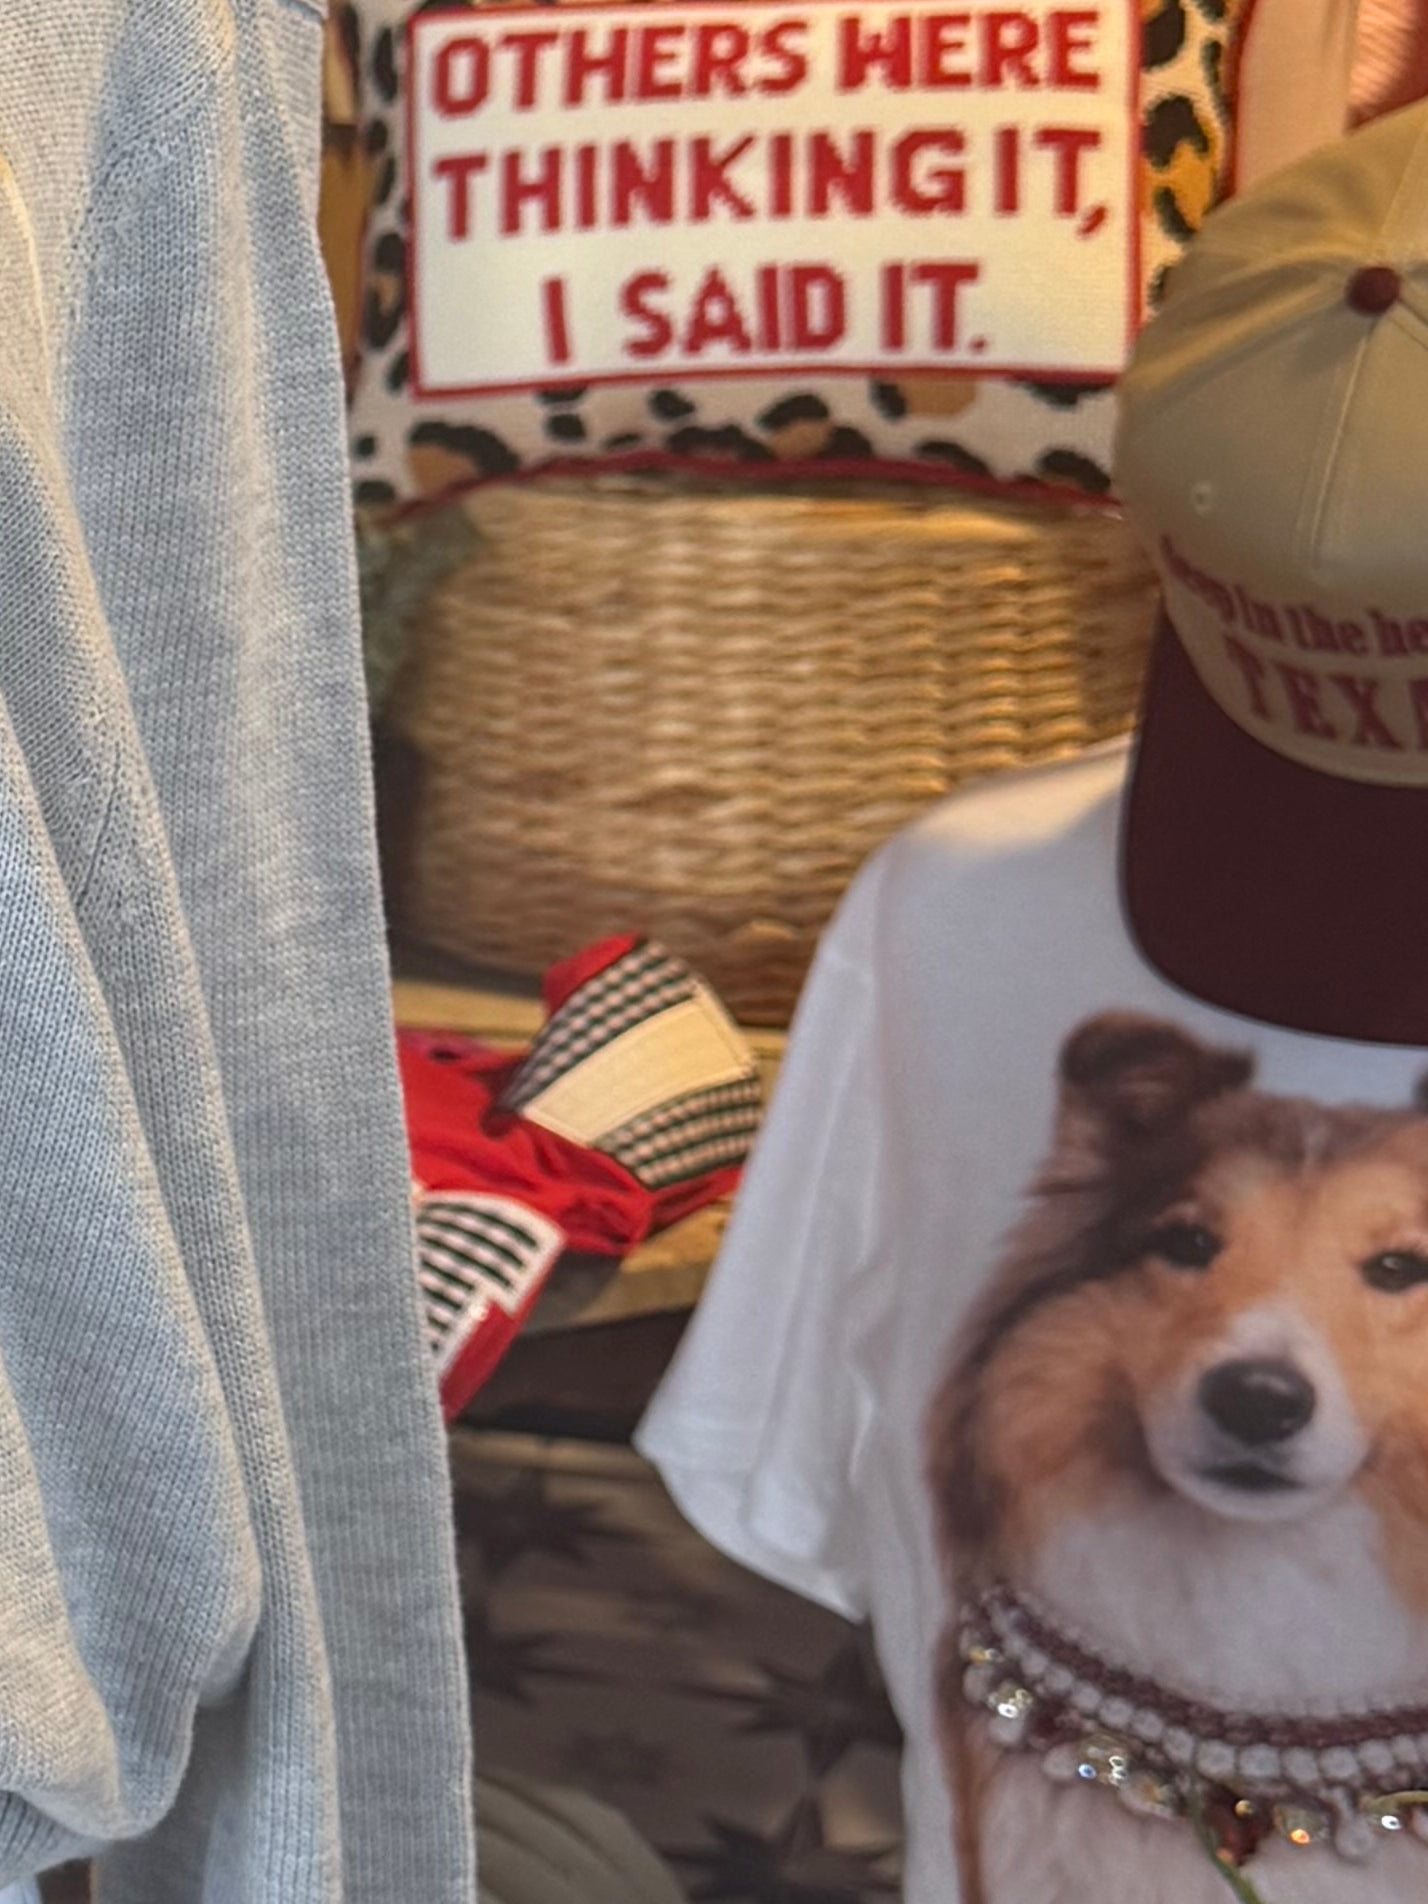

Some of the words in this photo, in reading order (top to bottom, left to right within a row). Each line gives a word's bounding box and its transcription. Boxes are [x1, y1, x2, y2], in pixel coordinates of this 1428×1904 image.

[433, 20, 808, 118] OTHERS
[838, 11, 1101, 92] WERE
[434, 128, 966, 240] THINKING
[990, 126, 1110, 236] IT,
[543, 279, 572, 364] I
[621, 265, 848, 358] SAID
[880, 261, 988, 357] IT.
